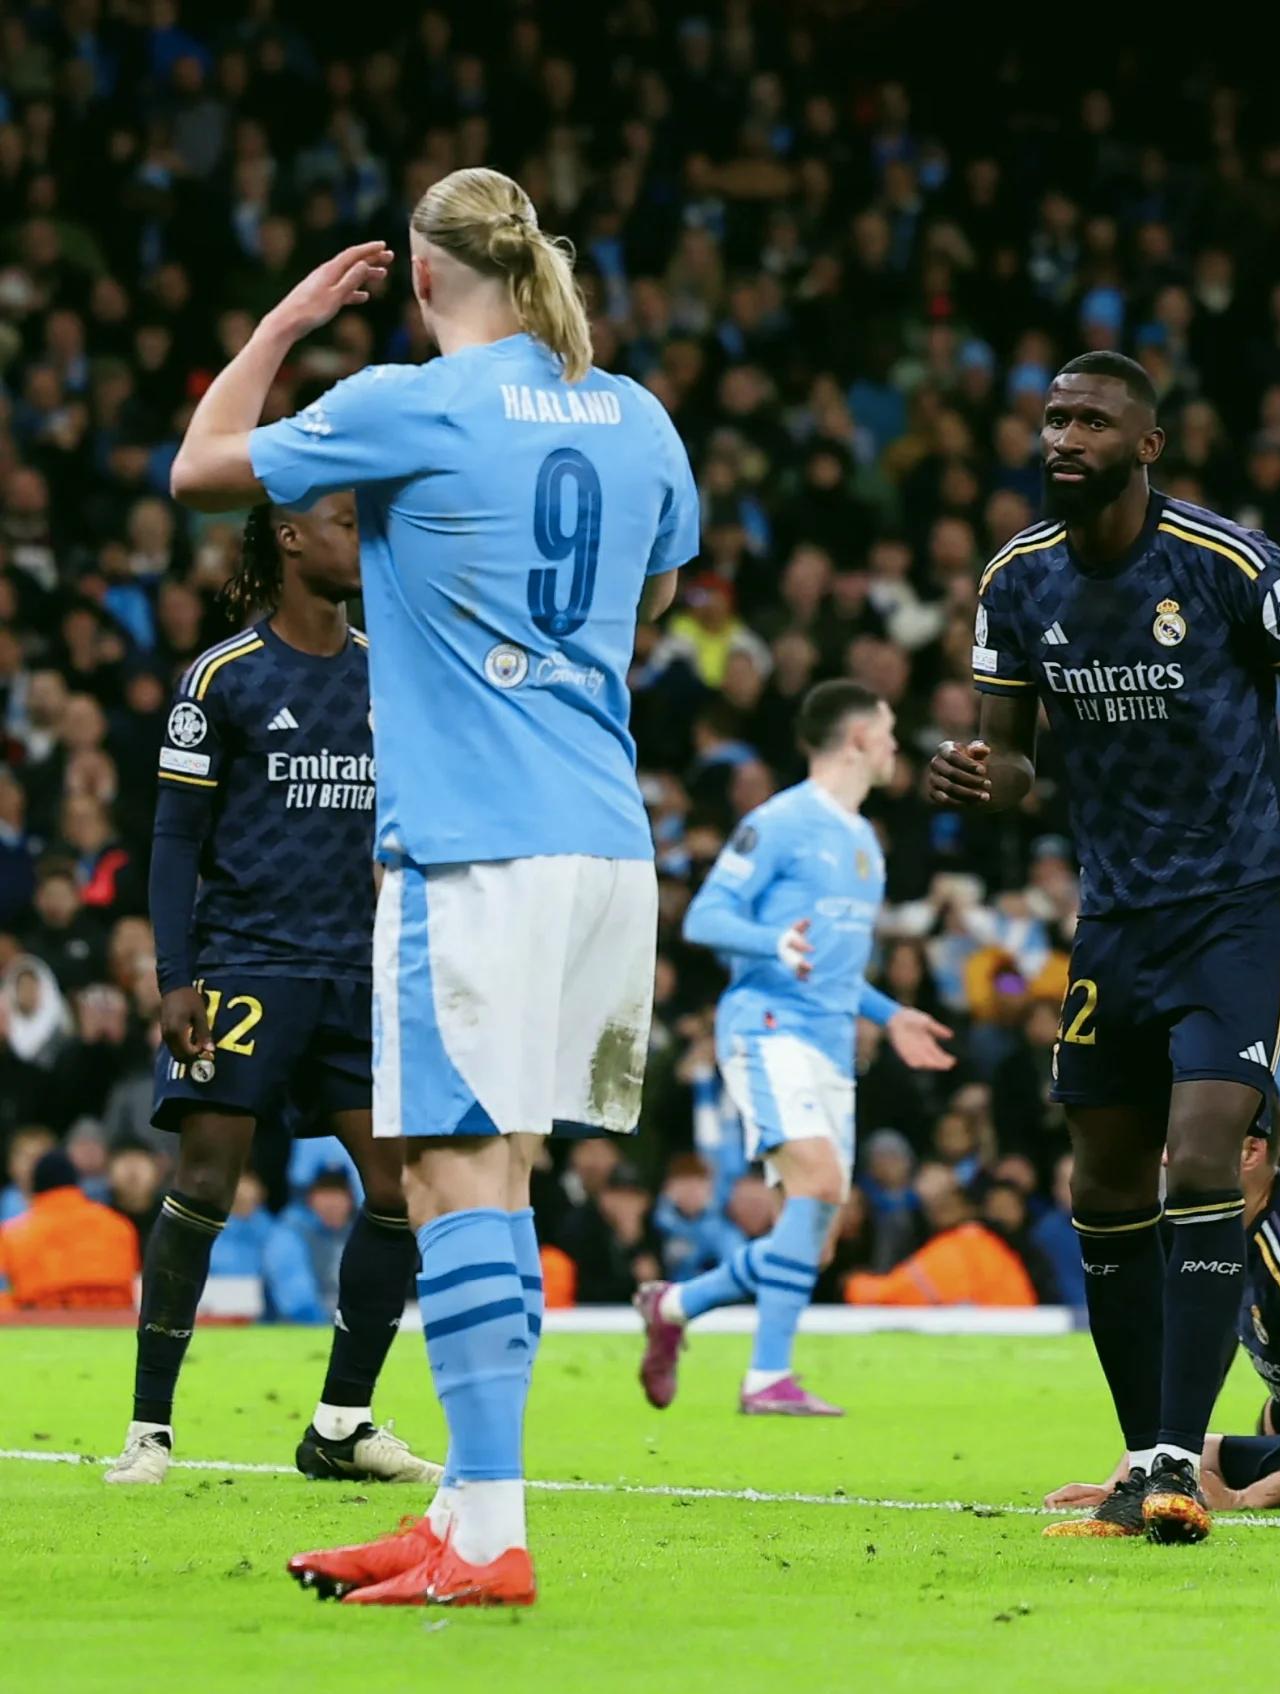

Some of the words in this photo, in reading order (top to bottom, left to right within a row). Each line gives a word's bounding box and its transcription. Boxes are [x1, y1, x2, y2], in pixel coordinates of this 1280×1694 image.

[500, 384, 622, 424] HAALAND
[527, 447, 602, 637] 9
[1042, 659, 1185, 694] Emirates
[1074, 698, 1101, 722] FLY
[1105, 696, 1169, 723] BETTER
[267, 748, 377, 782] Emirat
[286, 784, 316, 808] FLY
[322, 784, 376, 810] BETTER
[1056, 979, 1098, 1045] 2
[1081, 1257, 1120, 1275] MCF
[1180, 1260, 1243, 1276] RMCF
